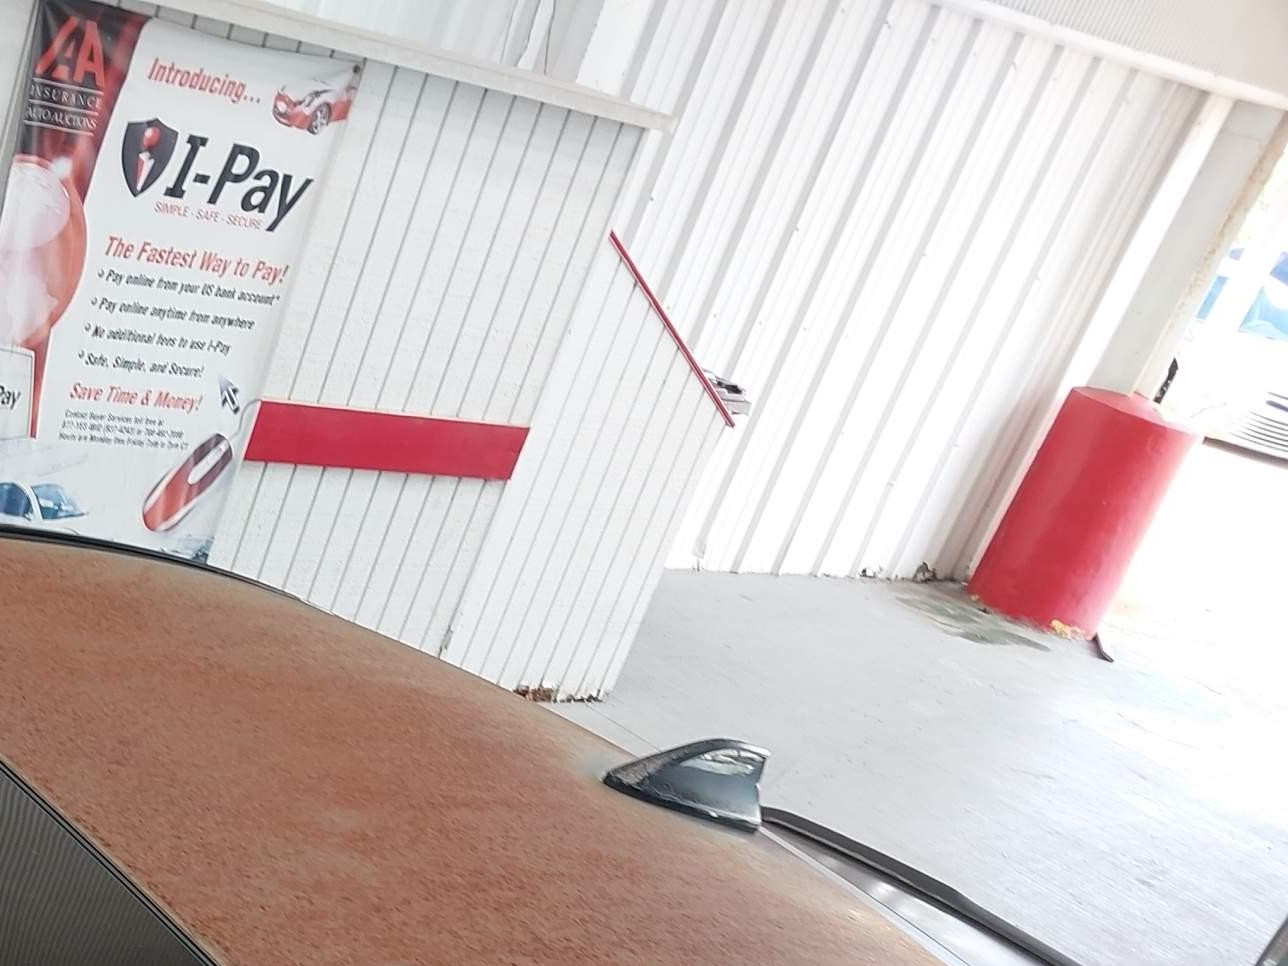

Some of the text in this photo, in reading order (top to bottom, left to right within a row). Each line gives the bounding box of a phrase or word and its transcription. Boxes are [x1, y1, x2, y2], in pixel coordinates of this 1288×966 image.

[148, 58, 261, 103] Introducing...
[30, 85, 103, 110] INSURANCE
[164, 134, 314, 232] I-Pay
[154, 201, 189, 216] SIMPLE
[196, 208, 219, 222] SAFE
[226, 213, 262, 230] SECURE
[105, 236, 290, 287] The Fastest Way to Pay!
[105, 268, 124, 286] Pay
[125, 272, 154, 288] online
[156, 276, 179, 291] from
[178, 279, 200, 295] your
[201, 283, 214, 296] US
[215, 284, 237, 299] bank
[98, 297, 255, 330] Pay online anytime from anywhere
[91, 324, 106, 338] No
[106, 327, 156, 346] additional
[156, 334, 177, 347] fees
[178, 336, 187, 349] to
[189, 339, 207, 350] use
[149, 361, 169, 375] and
[169, 363, 205, 379] Secure!
[69, 382, 204, 415] Save Time & Money!
